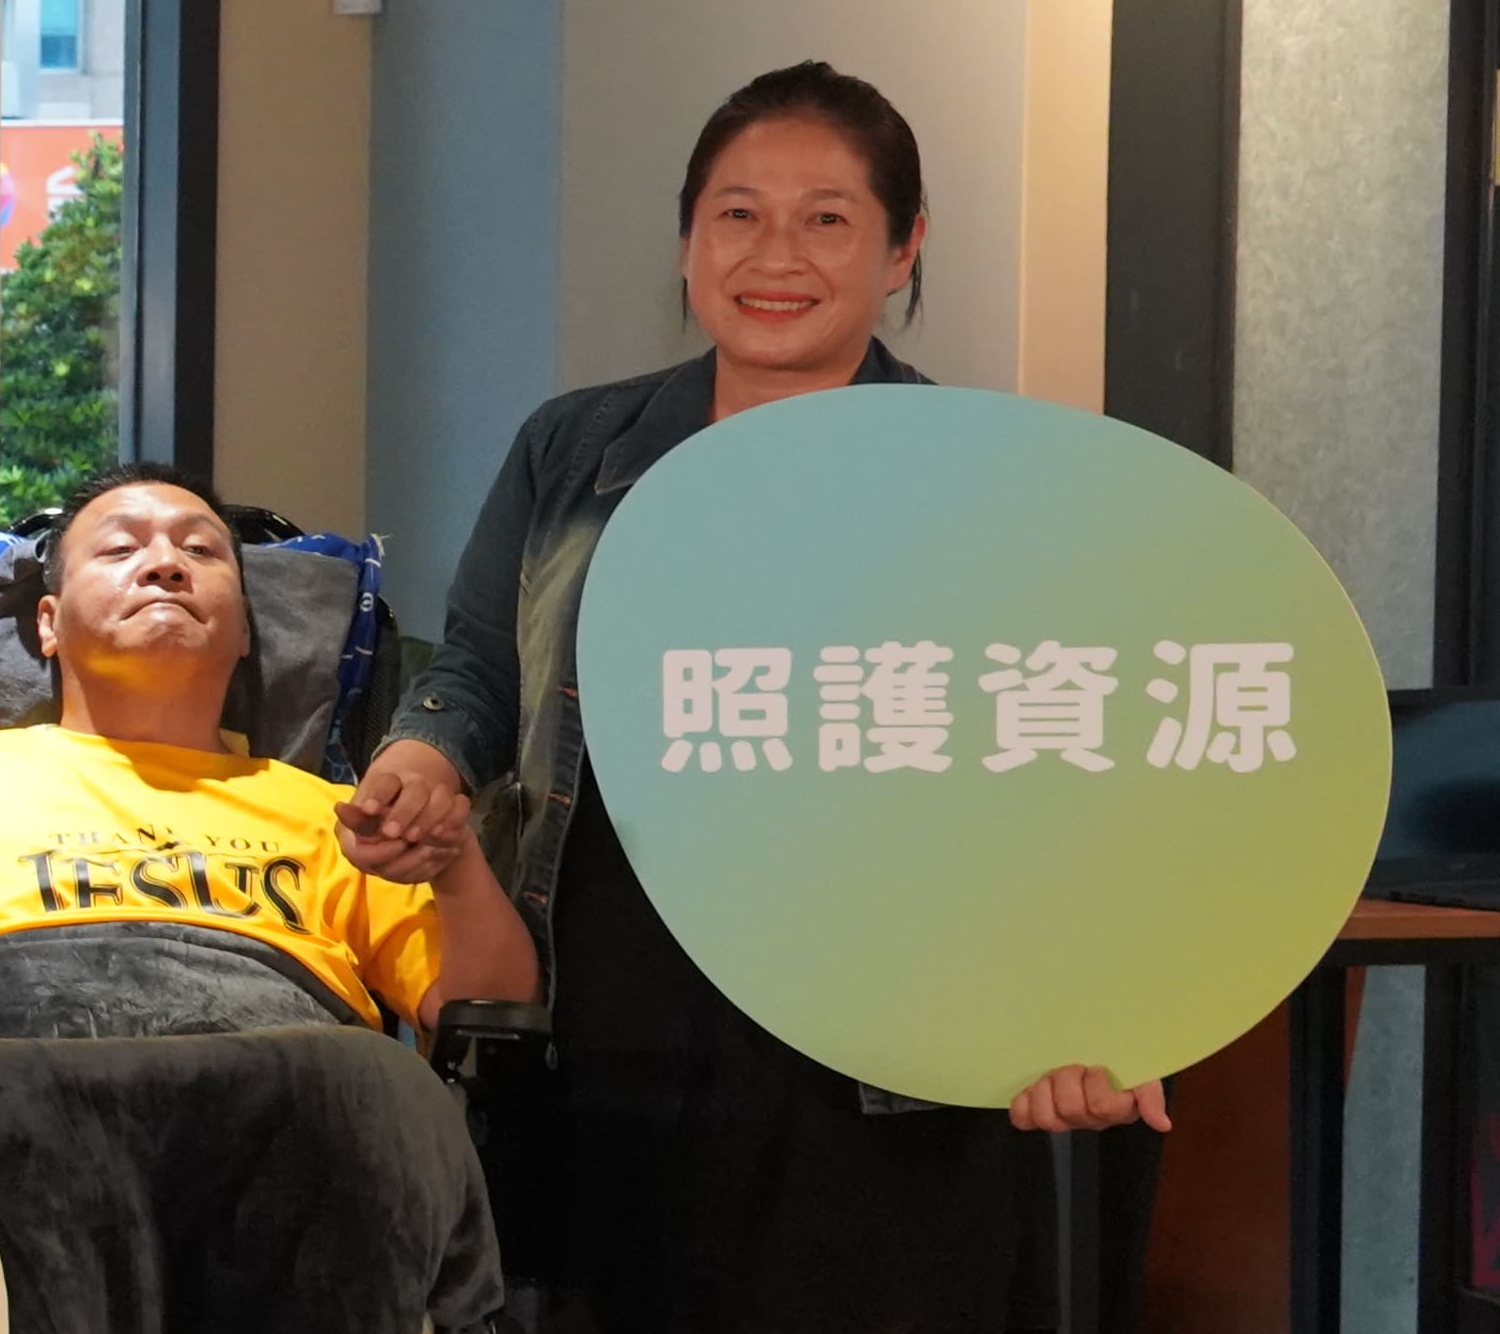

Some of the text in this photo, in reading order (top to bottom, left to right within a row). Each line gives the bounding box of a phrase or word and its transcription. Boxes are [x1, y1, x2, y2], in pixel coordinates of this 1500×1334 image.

[660, 640, 1297, 773] 照護資源
[50, 823, 281, 853] THAN YOU
